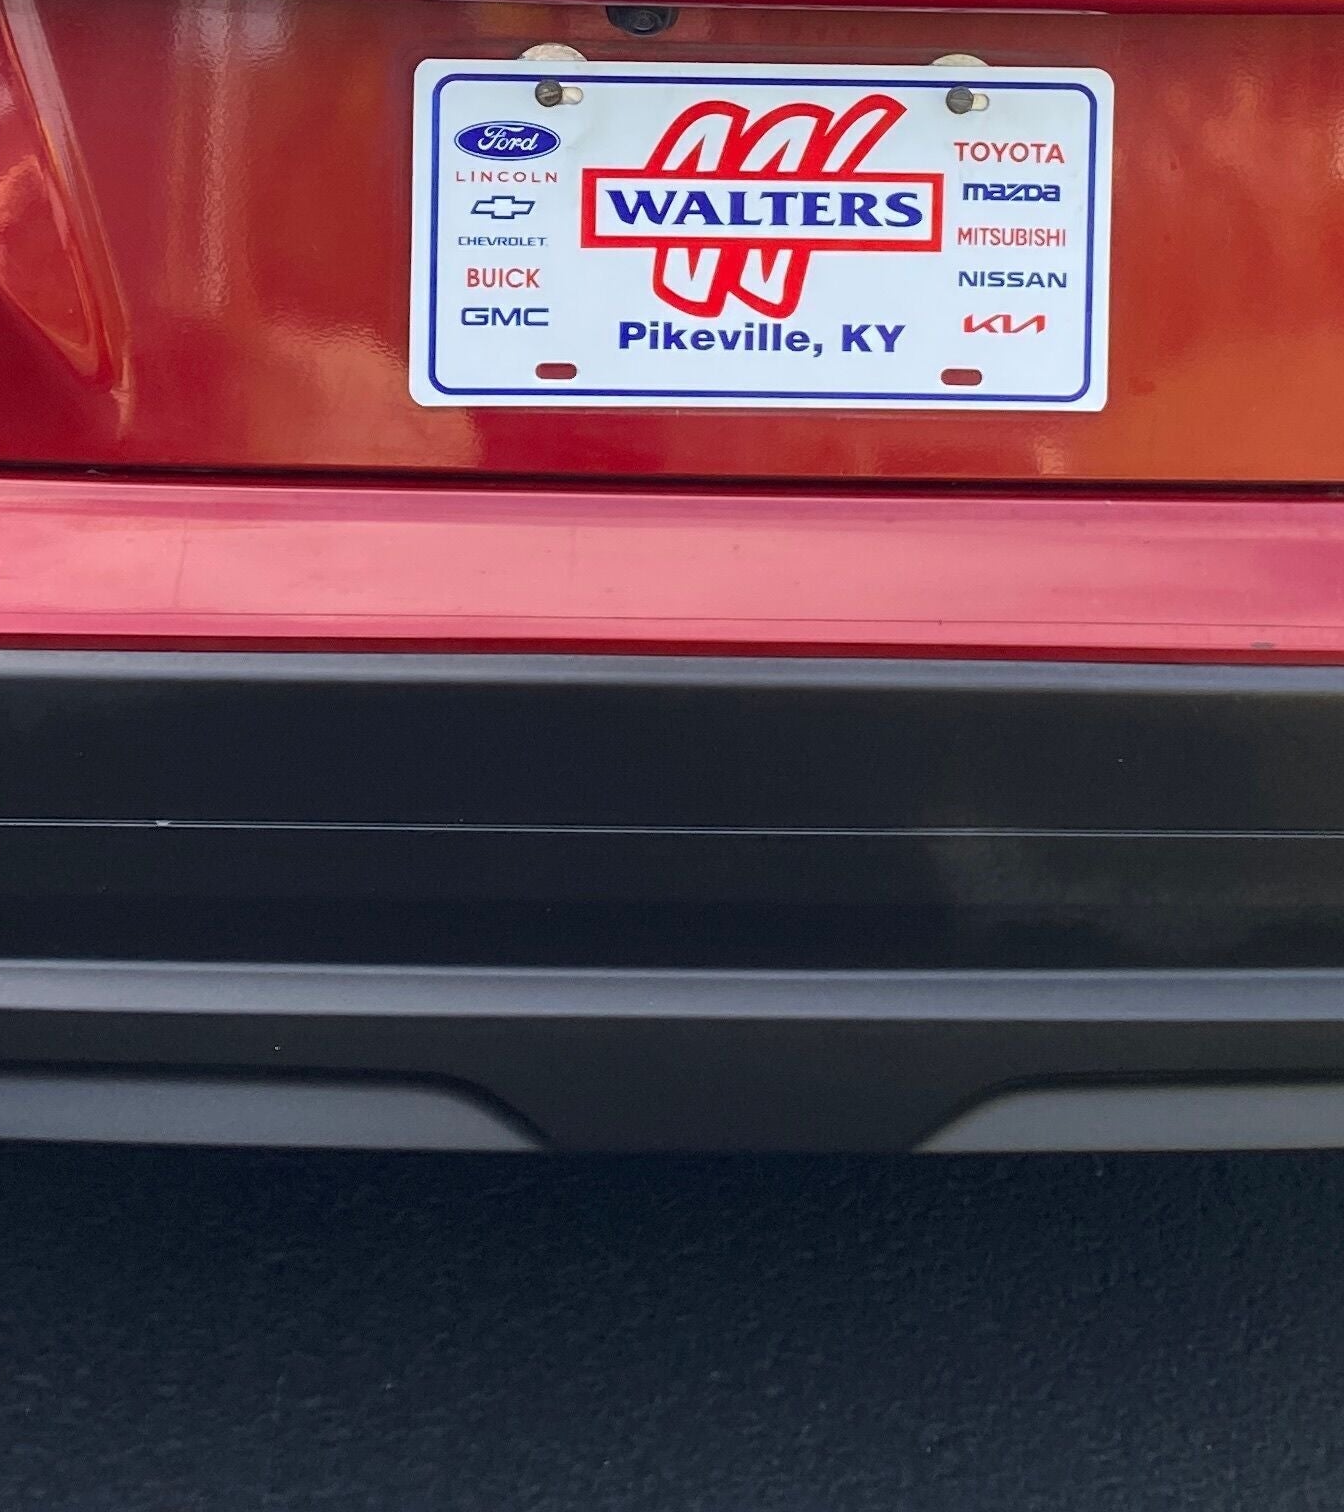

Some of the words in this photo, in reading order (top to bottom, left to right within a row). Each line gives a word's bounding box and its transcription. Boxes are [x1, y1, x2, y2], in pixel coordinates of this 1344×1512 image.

[477, 125, 540, 153] Ford
[953, 142, 1065, 164] TOYOTA
[455, 170, 558, 184] LINCOLN
[607, 189, 924, 228] WALTERS
[457, 236, 548, 247] CHEVROLET
[957, 227, 1066, 247] MITSUBISHI
[466, 267, 541, 289] BUICK
[958, 270, 1067, 289] NISSAN
[460, 307, 550, 327] GMC
[963, 313, 1046, 334] KIA
[618, 321, 824, 358] Pikeville,
[840, 324, 907, 353] KY
